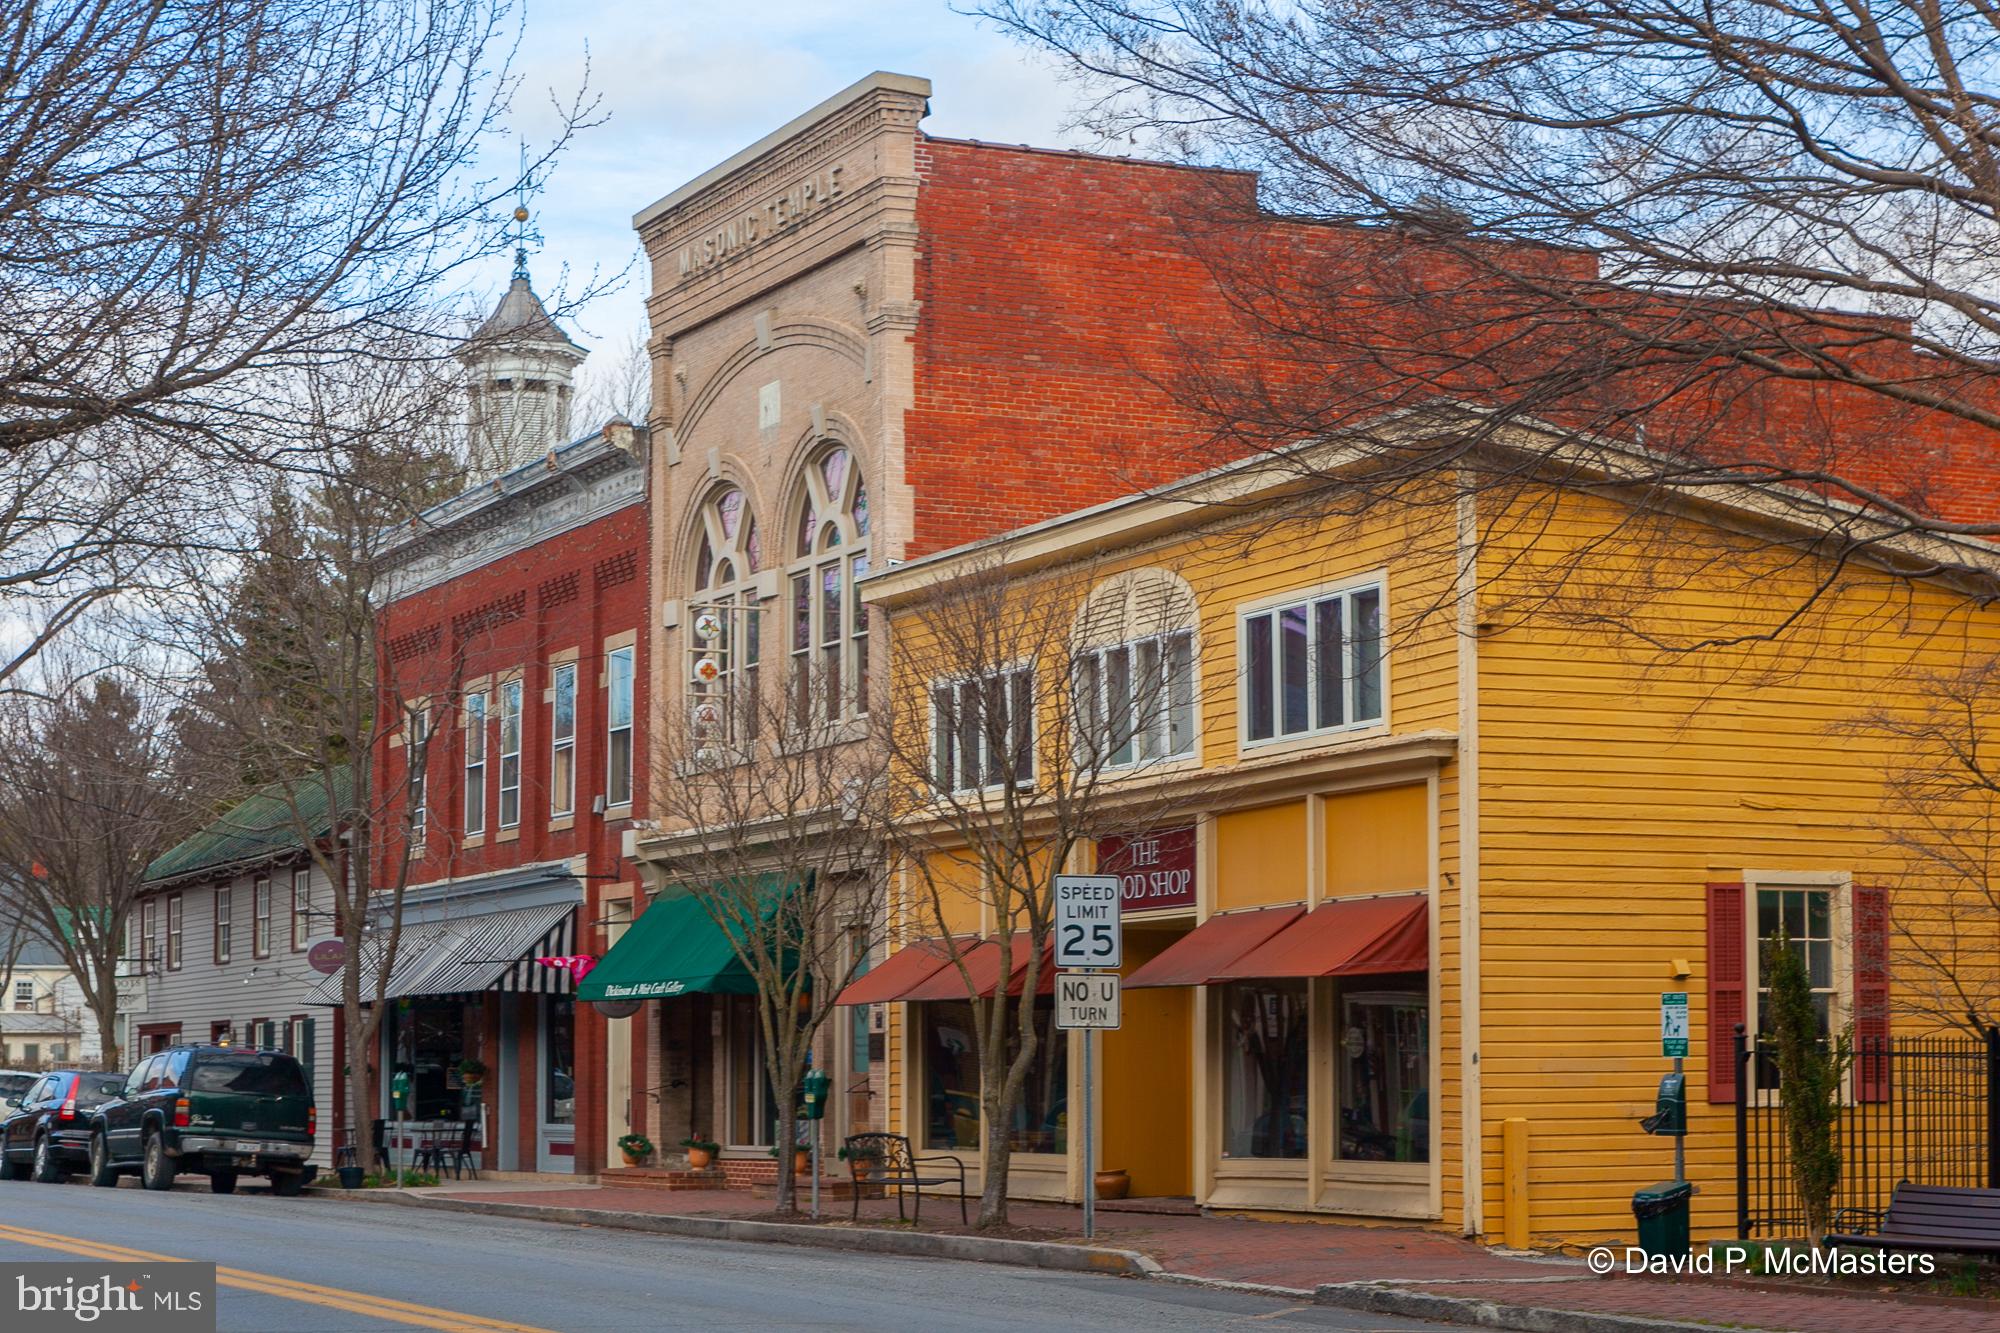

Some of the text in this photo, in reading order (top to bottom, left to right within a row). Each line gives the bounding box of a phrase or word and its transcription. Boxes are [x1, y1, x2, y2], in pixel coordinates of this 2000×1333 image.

[679, 164, 843, 278] MASONIC TEMPLE
[1130, 840, 1160, 866] THE
[1060, 886, 1115, 901] SPEED
[1149, 868, 1191, 897] SHOP
[1066, 905, 1109, 919] LIMIT
[1062, 923, 1114, 956] 25
[1063, 981, 1113, 1001] NO U
[1069, 1006, 1108, 1021] TURN
